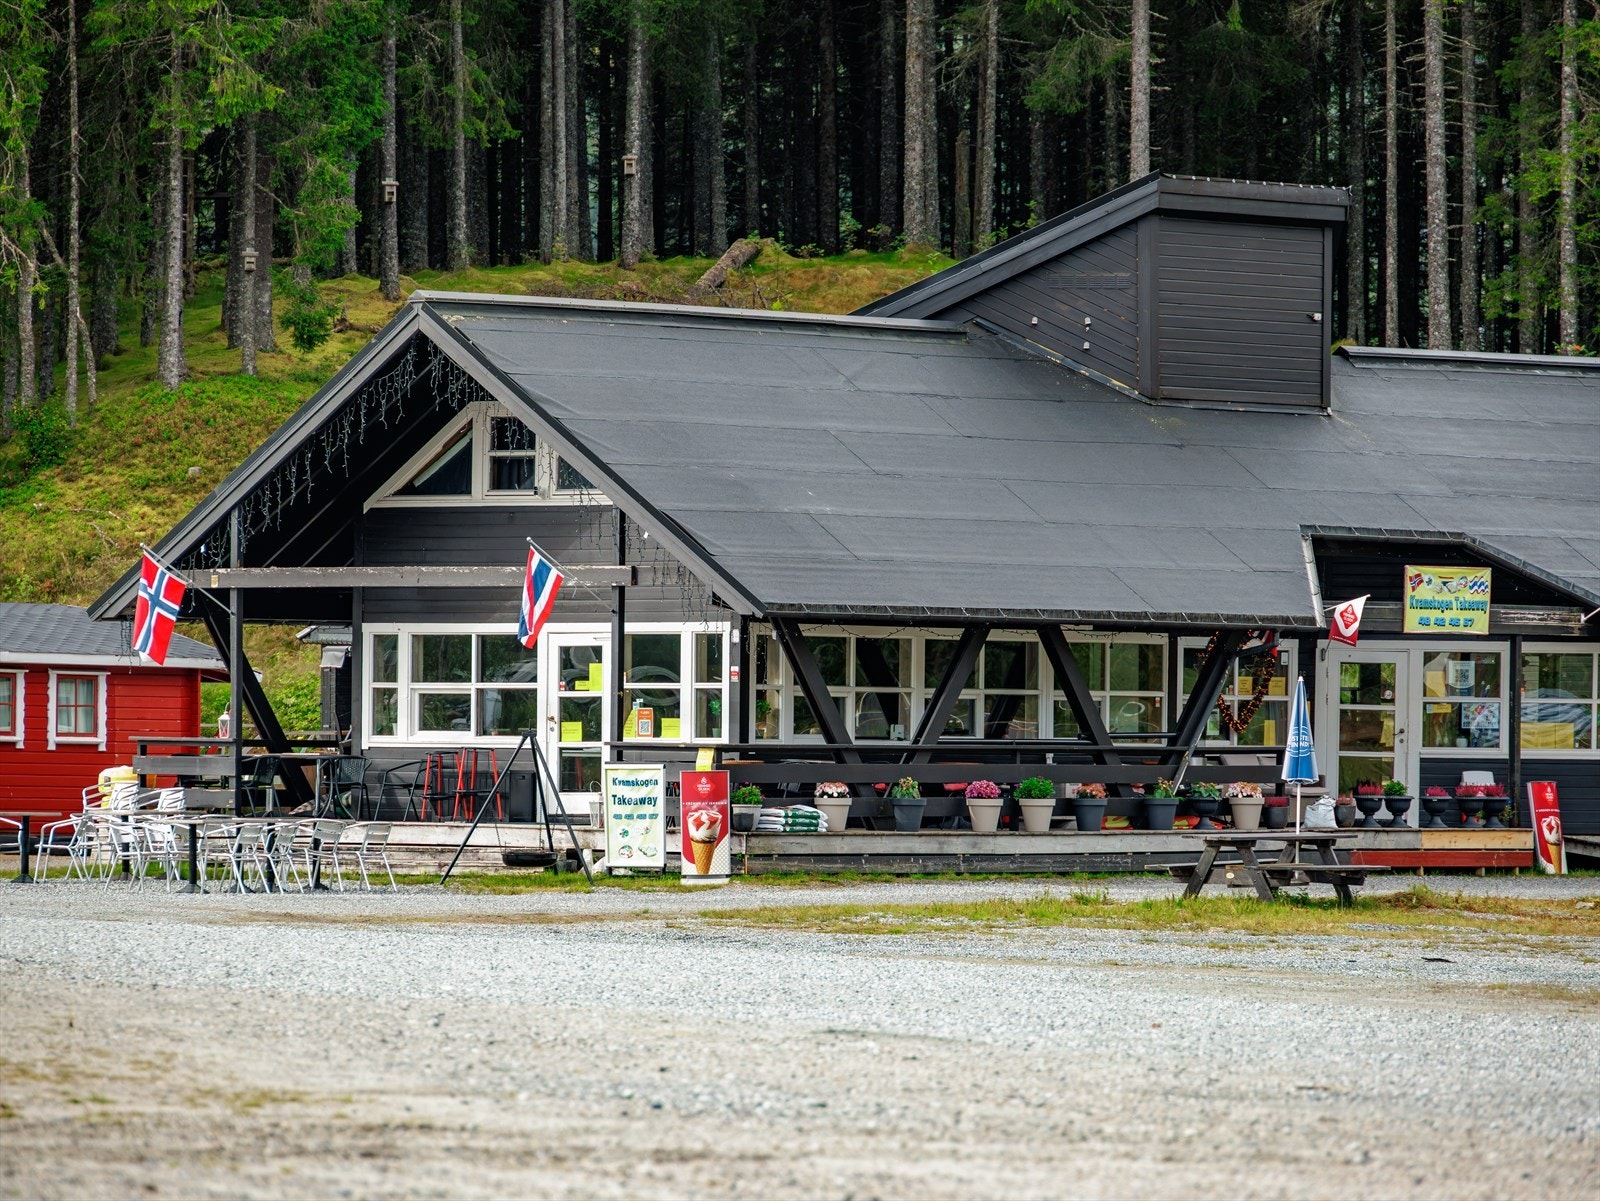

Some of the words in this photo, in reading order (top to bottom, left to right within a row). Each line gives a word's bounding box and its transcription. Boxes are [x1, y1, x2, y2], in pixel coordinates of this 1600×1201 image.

[1410, 595, 1453, 613] Kvamskogen
[1454, 596, 1489, 614] Takeaway
[612, 777, 658, 787] Kvamskogen
[612, 795, 658, 807] Takeaway
